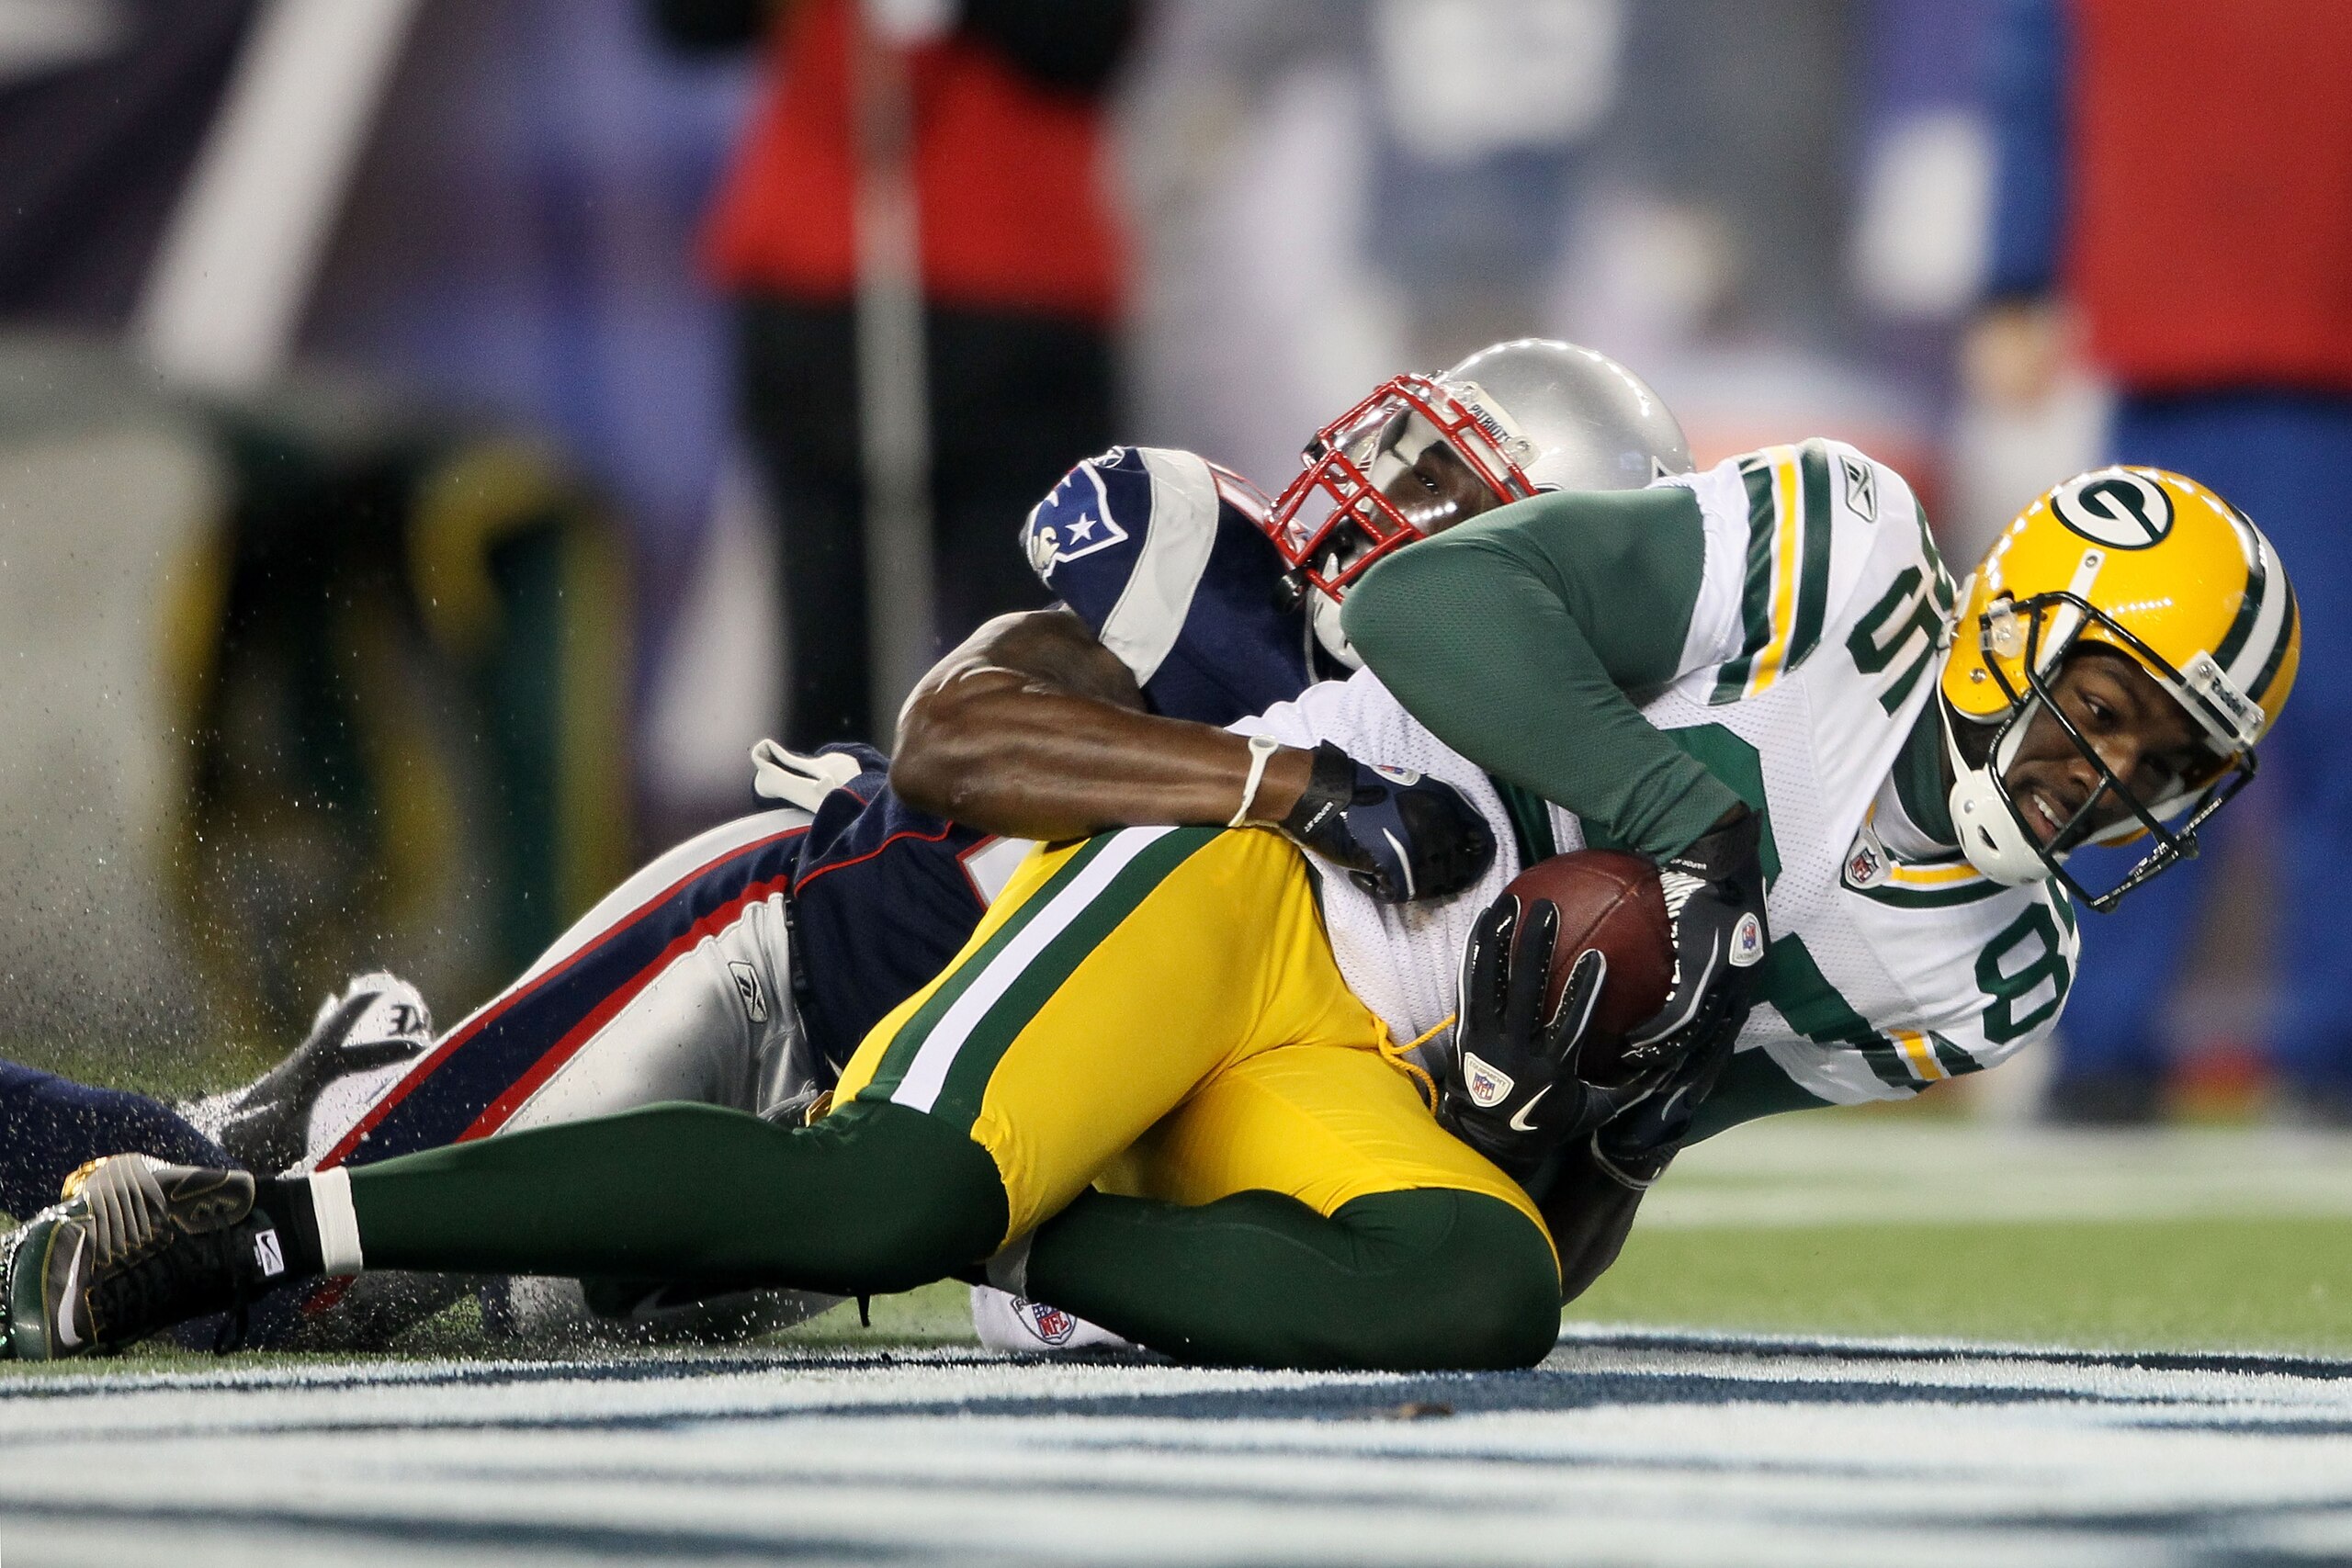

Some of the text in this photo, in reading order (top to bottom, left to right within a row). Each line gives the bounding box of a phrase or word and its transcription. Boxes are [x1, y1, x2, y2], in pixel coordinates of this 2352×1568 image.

[2053, 468, 2170, 547] G
[1473, 1079, 1495, 1100] NFL
[1039, 1311, 1069, 1337] NFL
